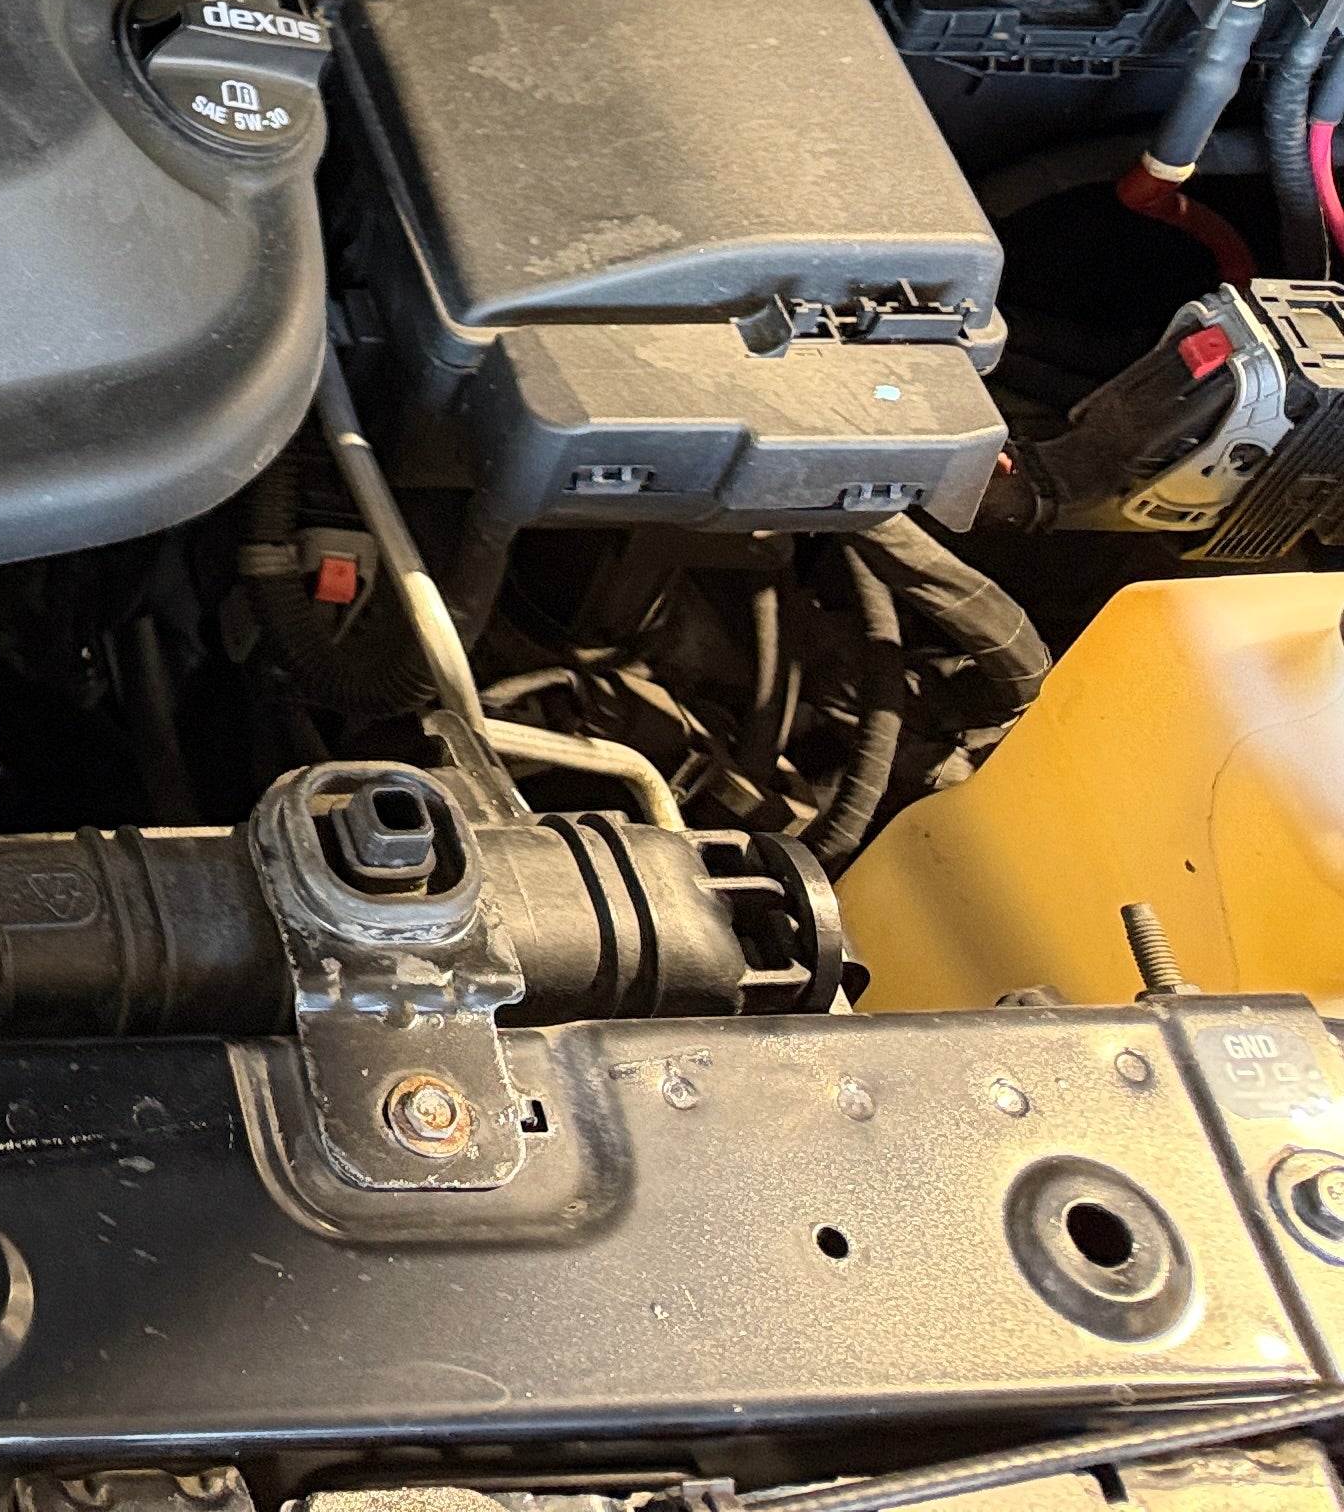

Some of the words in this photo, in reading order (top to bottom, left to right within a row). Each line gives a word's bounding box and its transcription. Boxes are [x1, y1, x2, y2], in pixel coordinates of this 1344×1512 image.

[202, 1, 322, 44] dexos
[191, 95, 228, 125] SAE
[234, 107, 291, 132] 5W-30
[1223, 1034, 1280, 1059] GND
